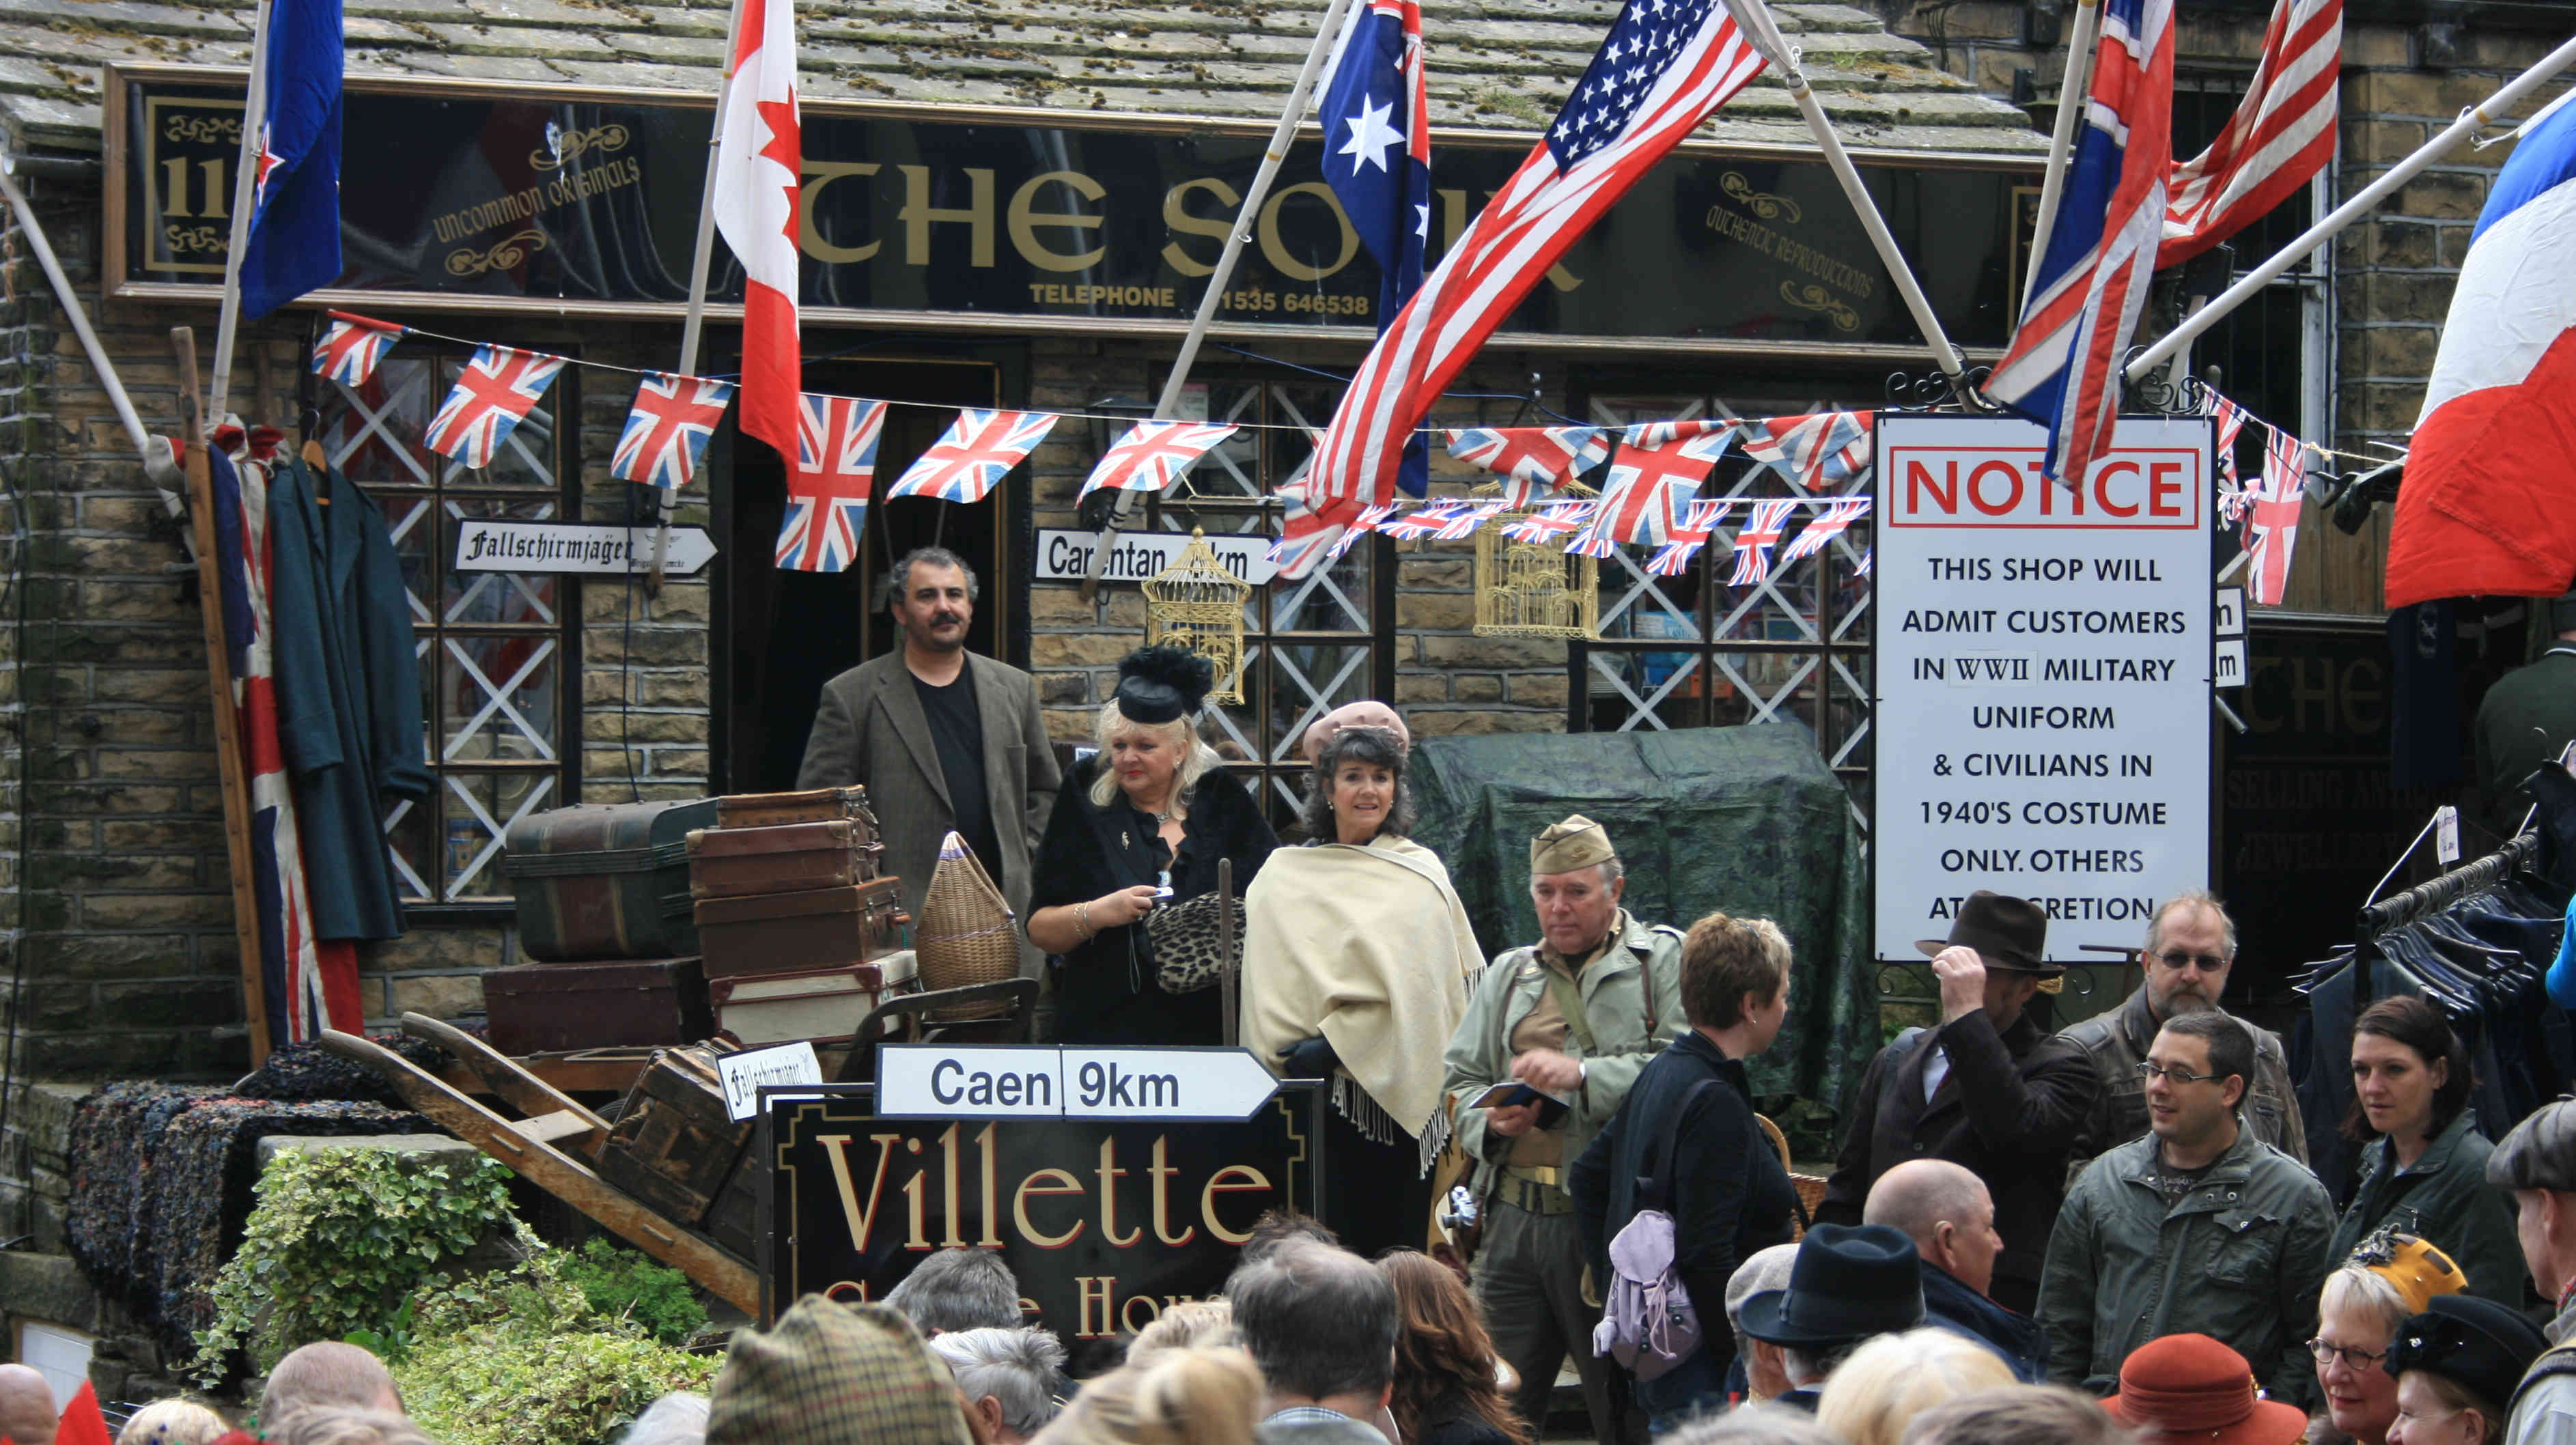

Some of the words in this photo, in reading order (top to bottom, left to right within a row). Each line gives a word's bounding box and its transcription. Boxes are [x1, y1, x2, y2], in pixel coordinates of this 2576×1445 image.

[799, 159, 1108, 272] THE
[1161, 178, 1584, 292] SO
[1029, 284, 1175, 307] TELEPHONE
[1221, 290, 1276, 311] 1535
[1283, 292, 1369, 315] 646538
[1049, 536, 1166, 577] Carntan
[1928, 557, 1991, 581] THIS
[2002, 558, 2084, 582] SHOP
[2094, 559, 2162, 582] WILL
[1902, 610, 1997, 633] ADMIT
[2006, 611, 2186, 634] CUSTOMERS
[1914, 658, 1944, 680] IN
[1955, 658, 2030, 681] WWII
[2044, 658, 2176, 682] MILITARY
[1973, 706, 2115, 729] UNIFORM
[1933, 754, 1952, 776] &
[1964, 754, 2110, 776] CIVILIANS
[2121, 755, 2153, 777] IN
[1920, 802, 2011, 825] 1940'S
[2023, 802, 2166, 825] COSTUME
[1940, 850, 2024, 873] ONLY.
[2030, 850, 2144, 873] OTHERS
[1929, 897, 1964, 920] AT
[2028, 897, 2153, 921] RETION
[931, 1058, 1051, 1106] Caen
[1078, 1061, 1179, 1108] 9km
[816, 1121, 1273, 1254] Villette
